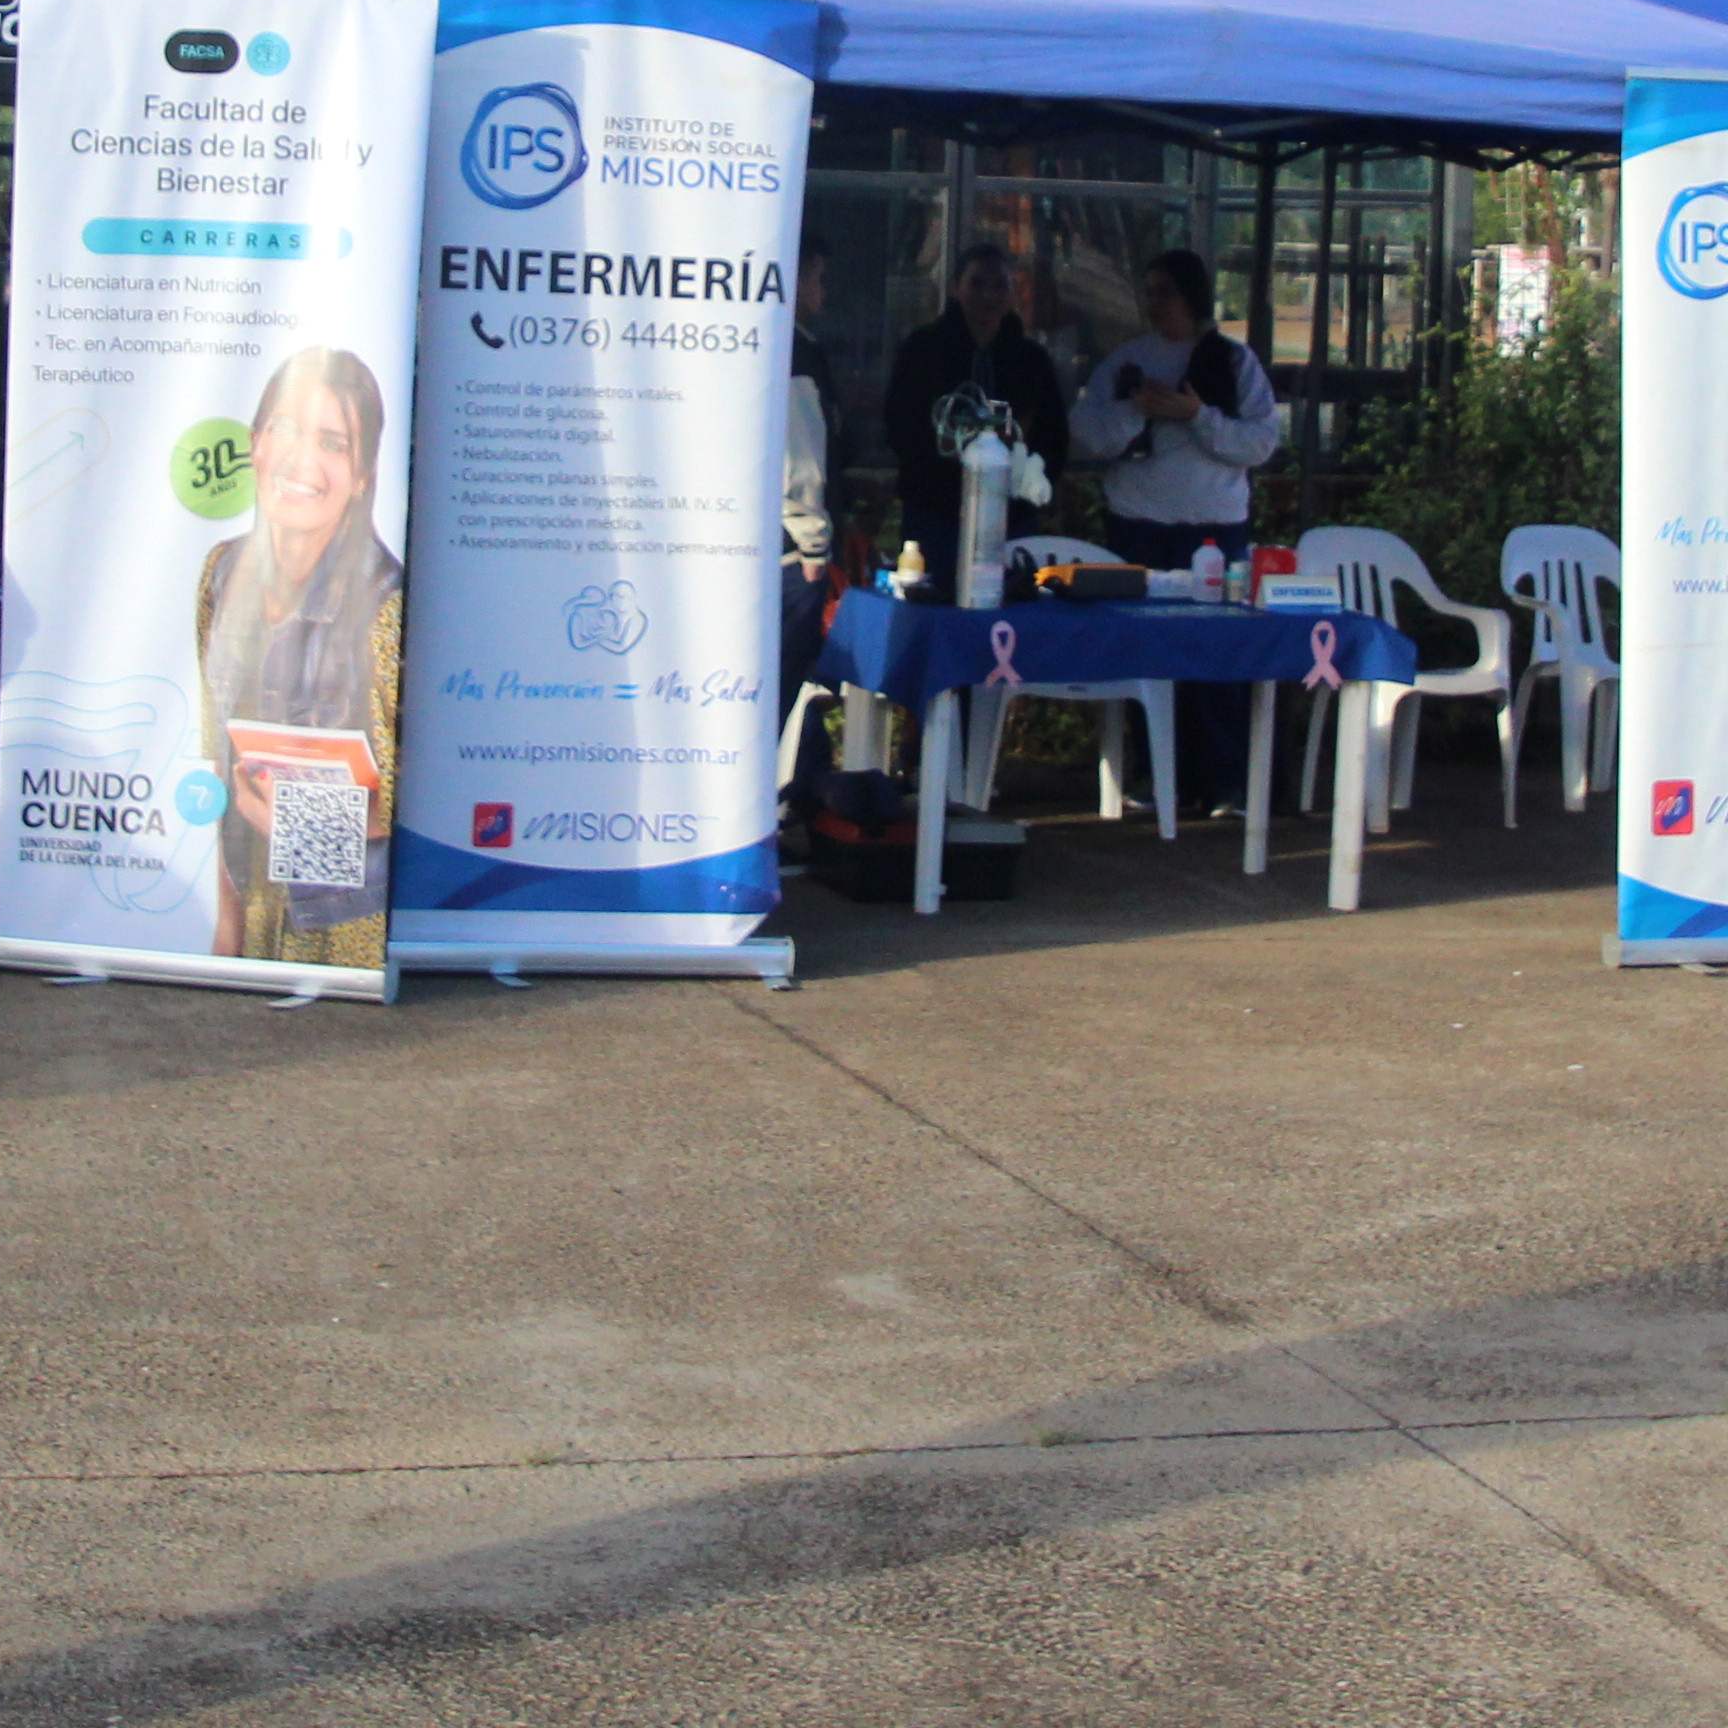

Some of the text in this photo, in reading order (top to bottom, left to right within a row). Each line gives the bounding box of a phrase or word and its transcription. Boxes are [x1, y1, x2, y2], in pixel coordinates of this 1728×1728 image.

[179, 44, 225, 60] FACSA
[144, 94, 306, 124] Facultad de
[604, 116, 735, 137] INSTITUTO DE
[71, 128, 372, 166] Ciencias de la Sal y
[488, 124, 564, 173] IPS
[603, 134, 777, 158] PREVISIÓN SOCIAL
[158, 168, 288, 196] Bienestar
[601, 155, 781, 193] MISIONES
[140, 230, 301, 248] CARRERAS
[47, 274, 261, 295] Licenciatura en Nutrición
[439, 244, 786, 304] ENFERMERÍA
[46, 305, 299, 329] Licenciatura en Fonoaudiolog
[46, 335, 80, 351] Tec.
[84, 341, 106, 352] en
[509, 315, 760, 352] (0376) 4448634
[33, 366, 135, 385] Terapéutico
[459, 741, 740, 766] www.ipsmisiones.com.ar
[22, 769, 153, 802] MUNDO
[21, 802, 165, 836] CUENCA
[523, 812, 698, 843] MISIONES
[20, 837, 102, 852] UNIVERSIDAD
[20, 850, 165, 870] DE LA CUENCA DEL PLATA
